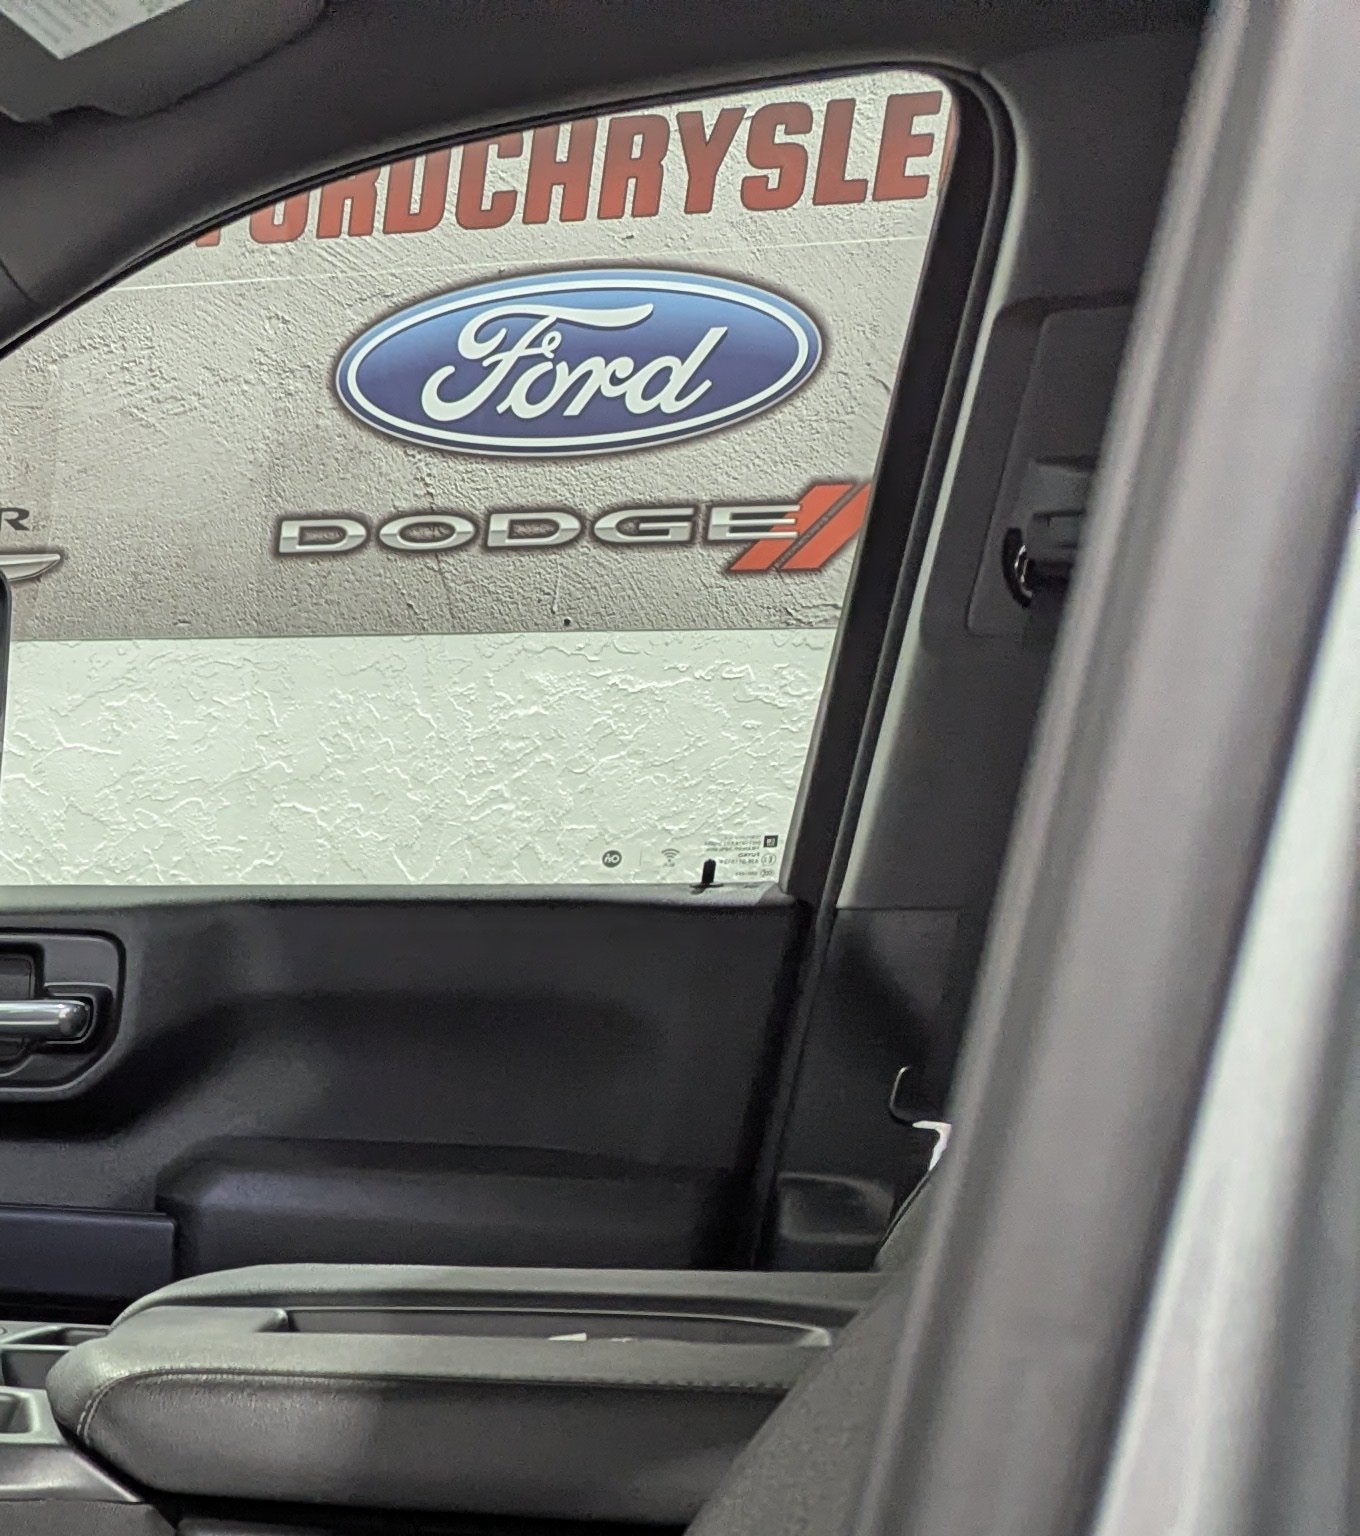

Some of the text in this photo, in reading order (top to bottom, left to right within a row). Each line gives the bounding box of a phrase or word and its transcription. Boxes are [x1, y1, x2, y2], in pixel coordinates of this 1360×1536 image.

[196, 90, 960, 247] RDCHRYSLE
[421, 302, 728, 422] Ford
[278, 502, 803, 556] DODGE
